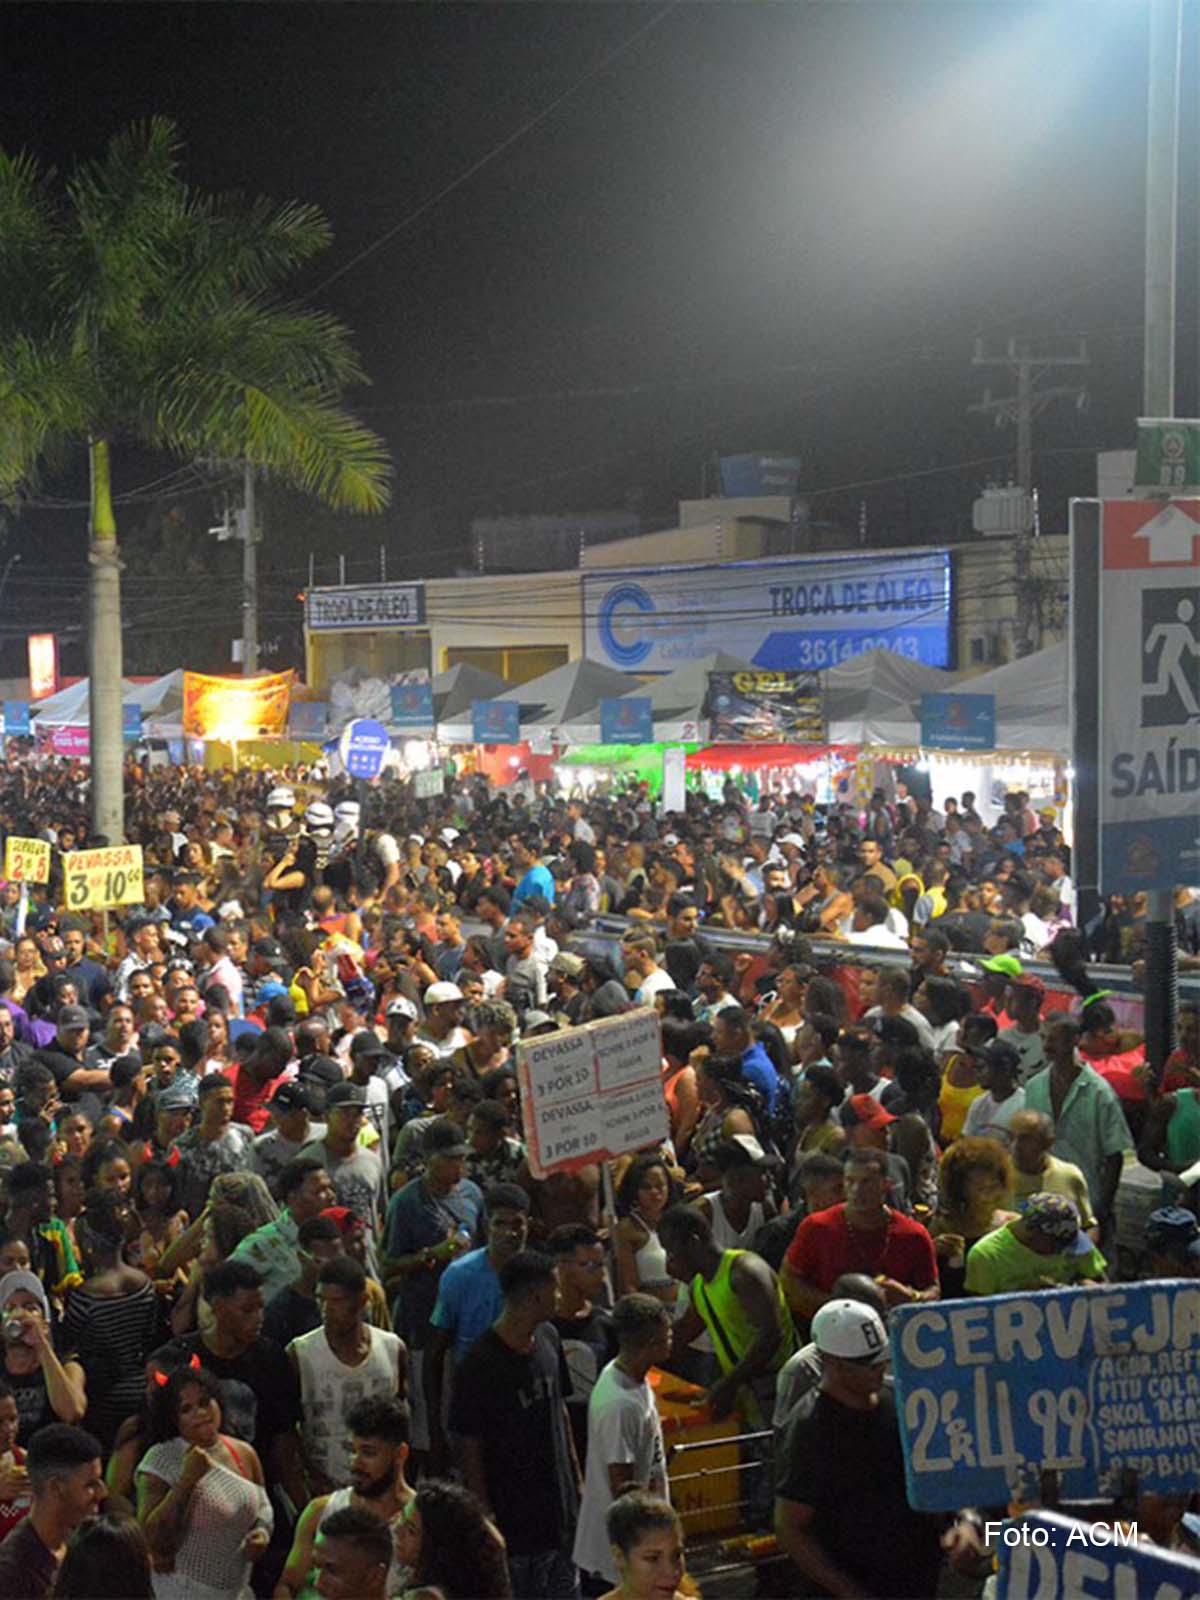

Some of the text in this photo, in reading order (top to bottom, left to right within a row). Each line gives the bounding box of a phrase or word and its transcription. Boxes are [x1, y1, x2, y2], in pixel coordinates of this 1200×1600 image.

[769, 585, 835, 617] TROCA
[842, 583, 869, 613] DE
[70, 873, 90, 905] 3
[555, 1137, 582, 1156] POR
[901, 1289, 1200, 1369] CERVEJA
[1098, 1396, 1200, 1429] SKOL BEA
[904, 1387, 955, 1473] 2
